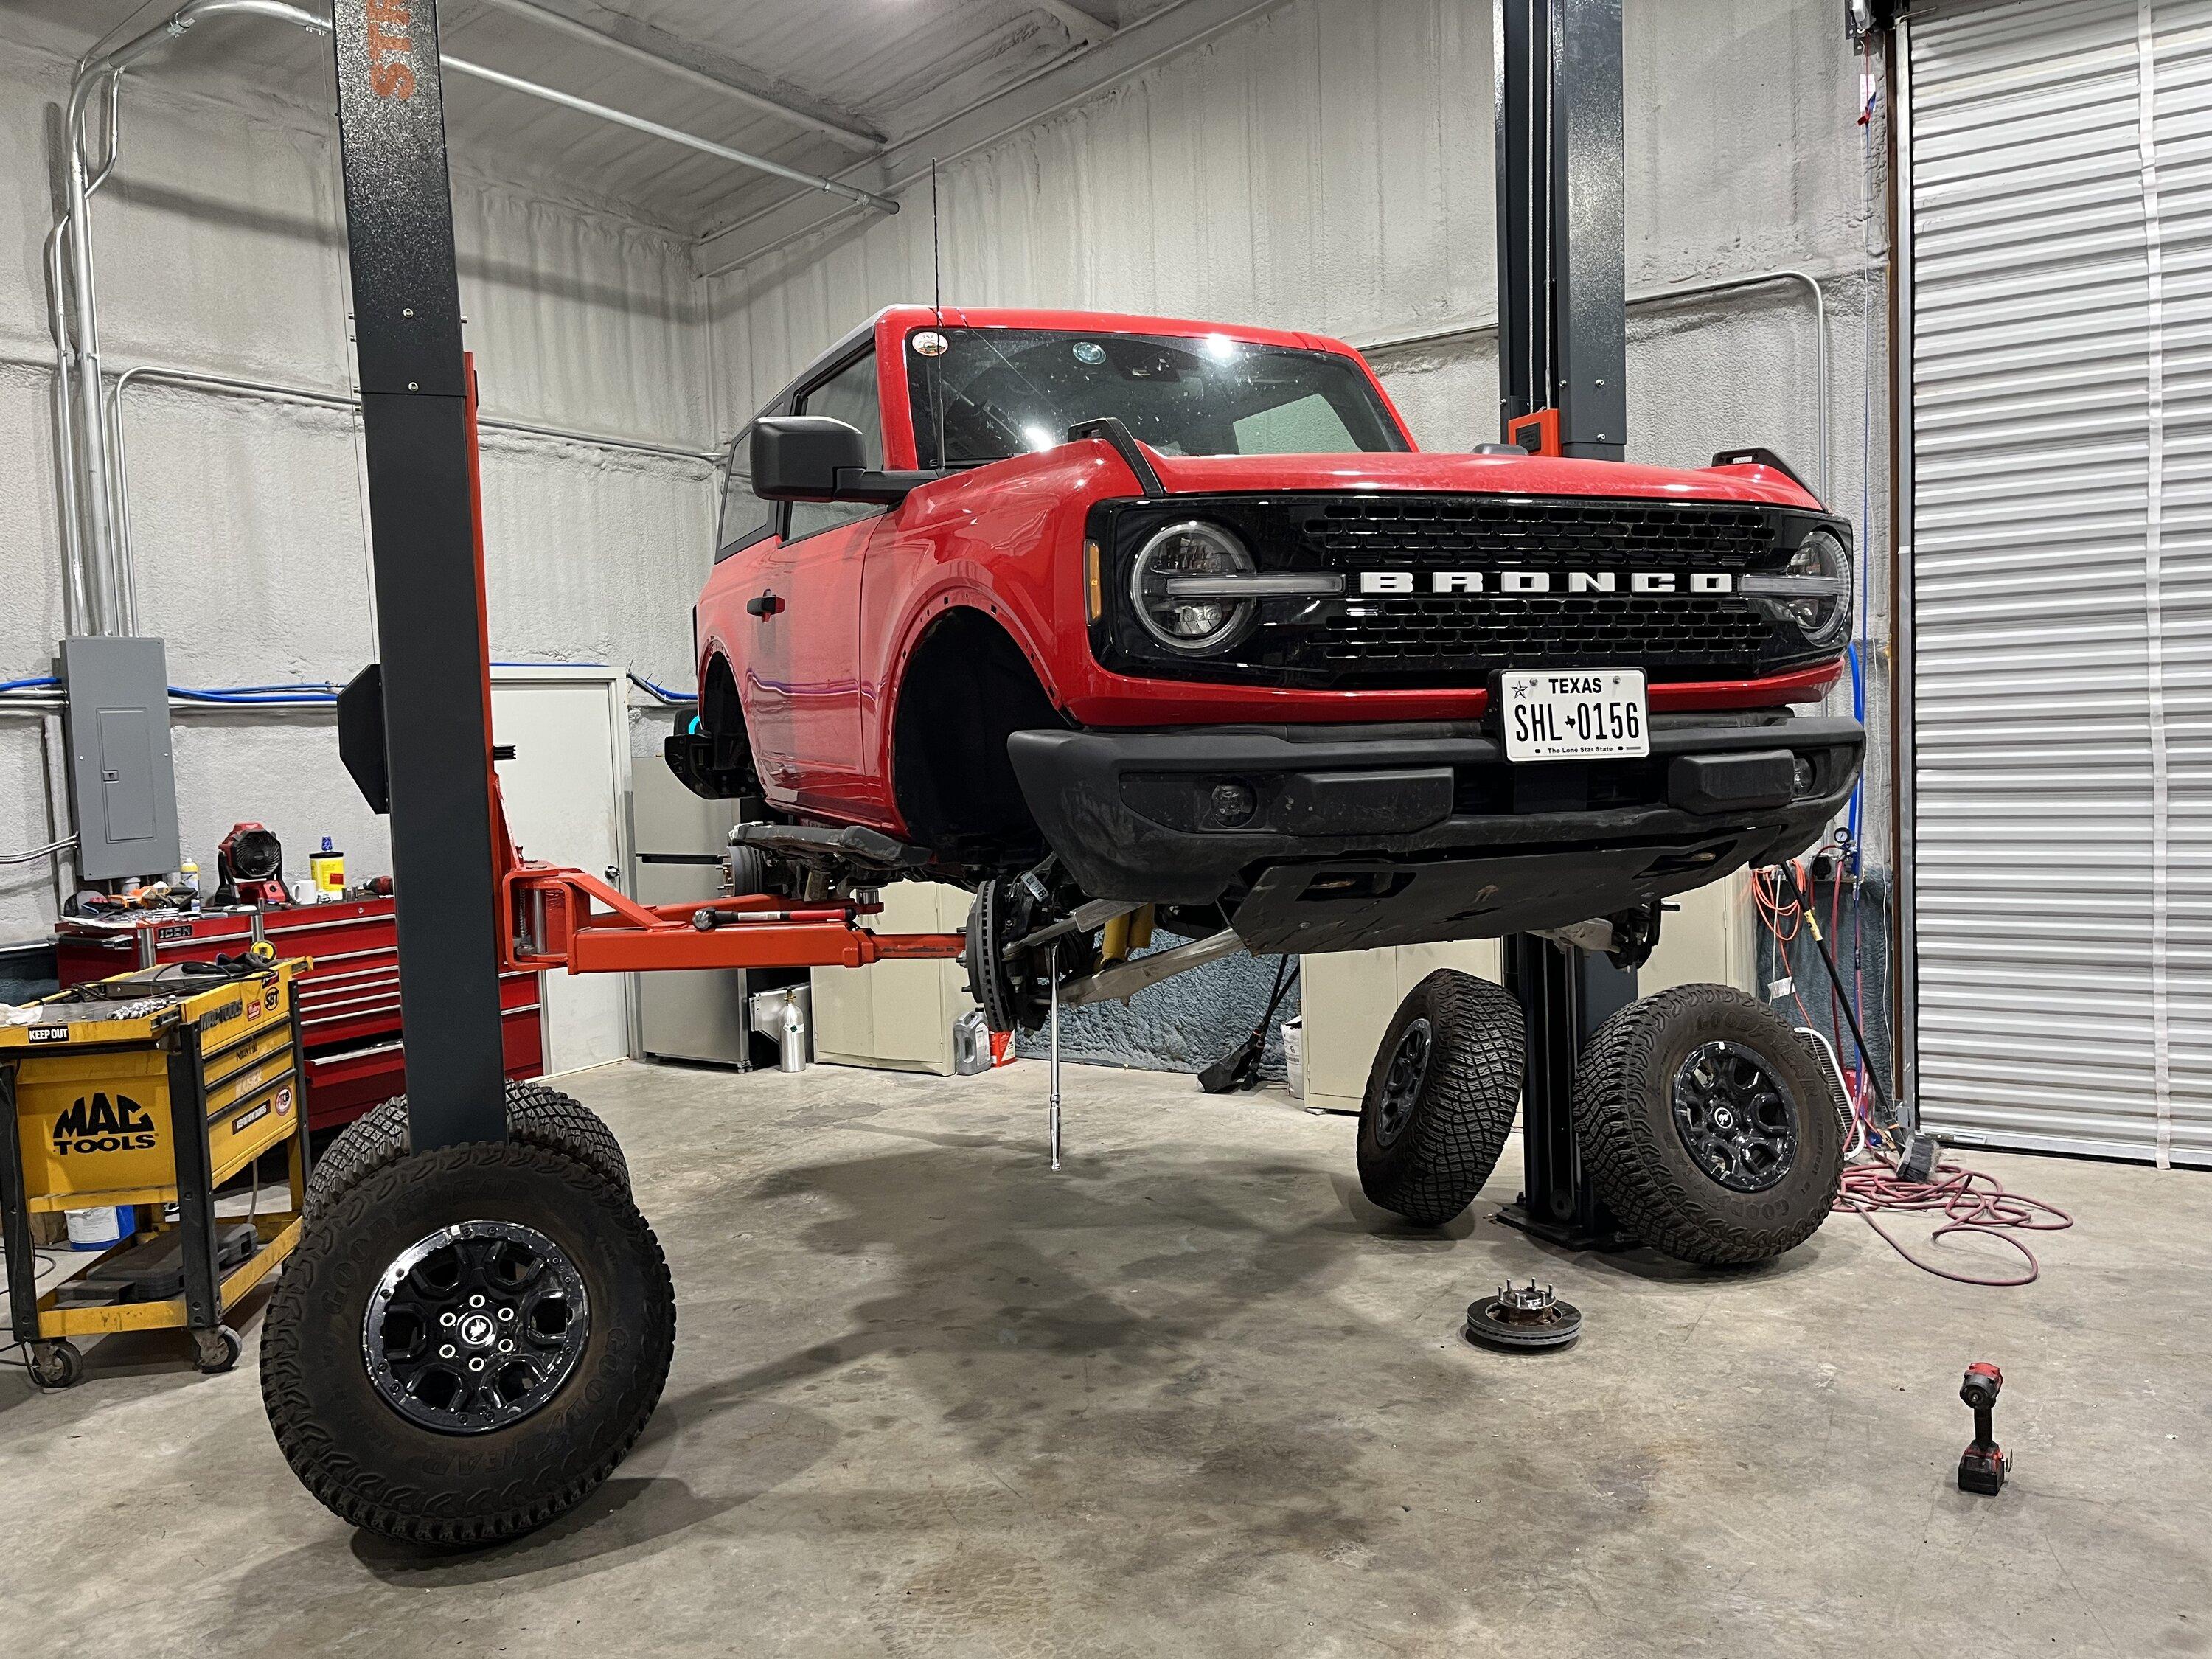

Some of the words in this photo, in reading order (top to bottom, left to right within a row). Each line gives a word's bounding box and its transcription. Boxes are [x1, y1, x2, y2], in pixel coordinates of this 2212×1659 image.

[1360, 571, 1732, 594] BRONCO
[1548, 678, 1602, 694] TEXAS
[1515, 703, 1562, 742] SHL
[1577, 702, 1640, 740] 0156
[160, 926, 190, 939] ICON
[29, 1029, 50, 1040] KEEP
[51, 1028, 68, 1039] OUT
[53, 1092, 155, 1139] MAC
[54, 1134, 156, 1155] TOOLS
